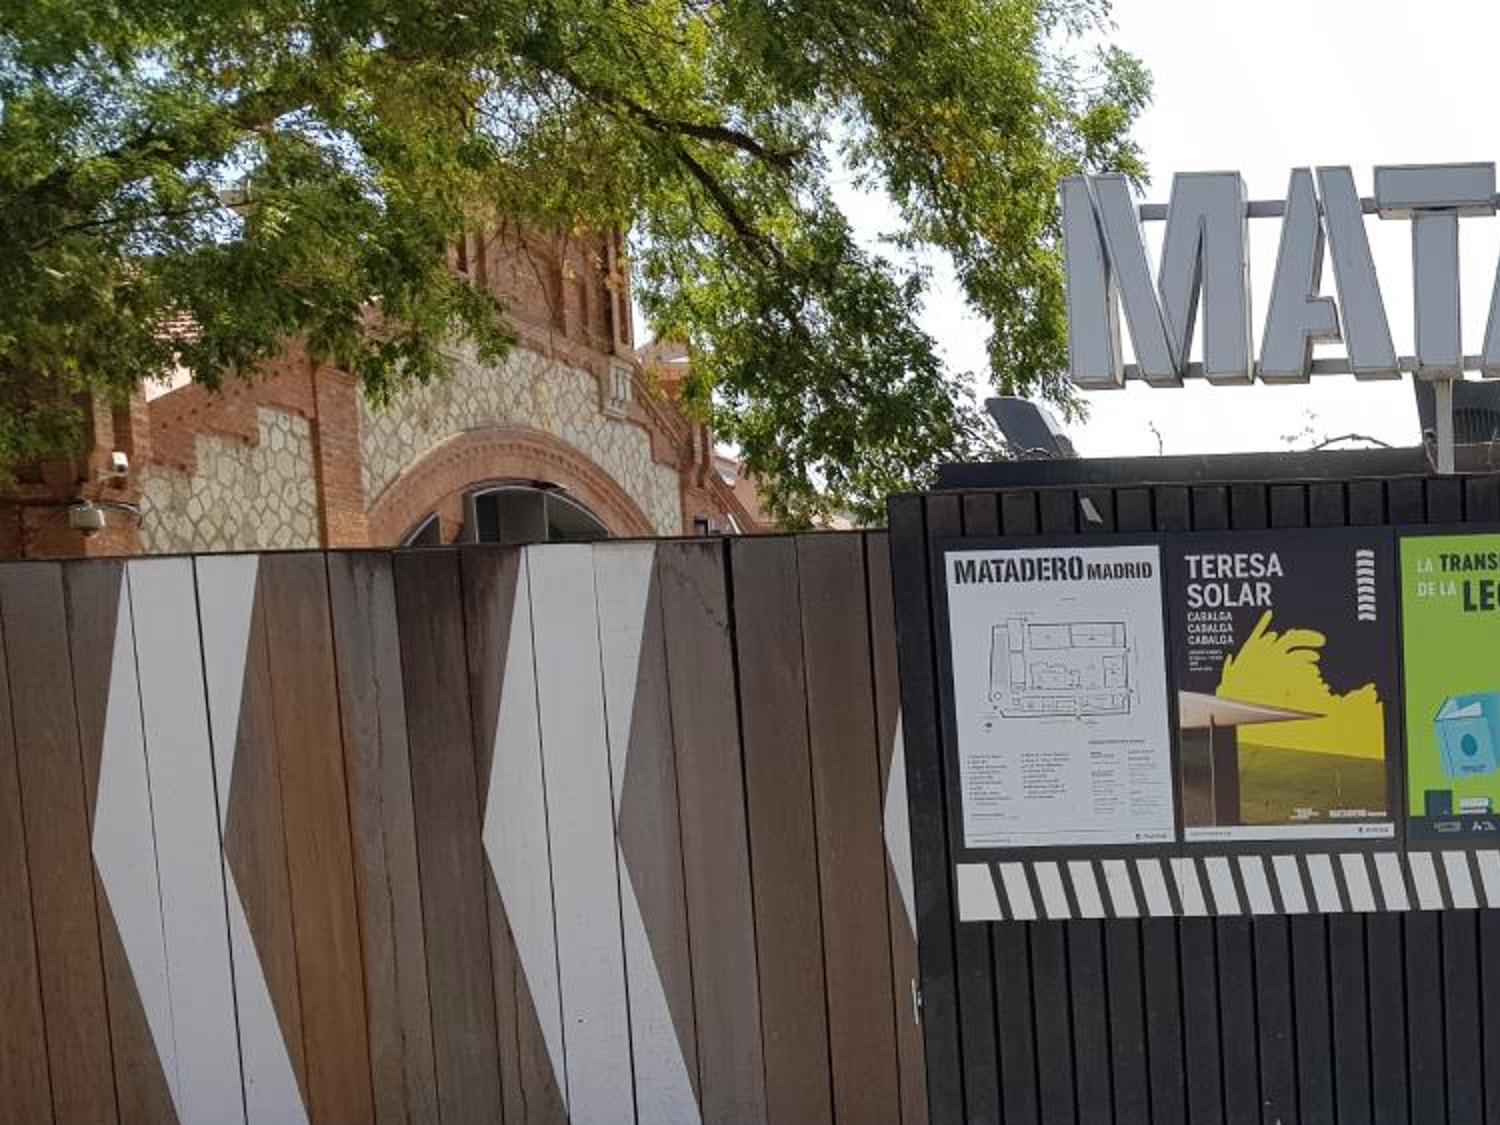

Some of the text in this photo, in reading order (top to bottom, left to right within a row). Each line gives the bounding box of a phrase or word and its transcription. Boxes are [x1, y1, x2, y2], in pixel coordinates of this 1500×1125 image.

[953, 556, 1153, 584] MATADERO MADRID
[1184, 552, 1283, 579] TERESA
[1417, 559, 1433, 573] LA
[1187, 582, 1272, 608] SOLAR
[1417, 582, 1436, 597] DE
[1439, 581, 1457, 596] LA
[1187, 611, 1233, 622] CABALGA
[1187, 623, 1233, 633] CABALGA
[1187, 635, 1234, 645] CABALGA
